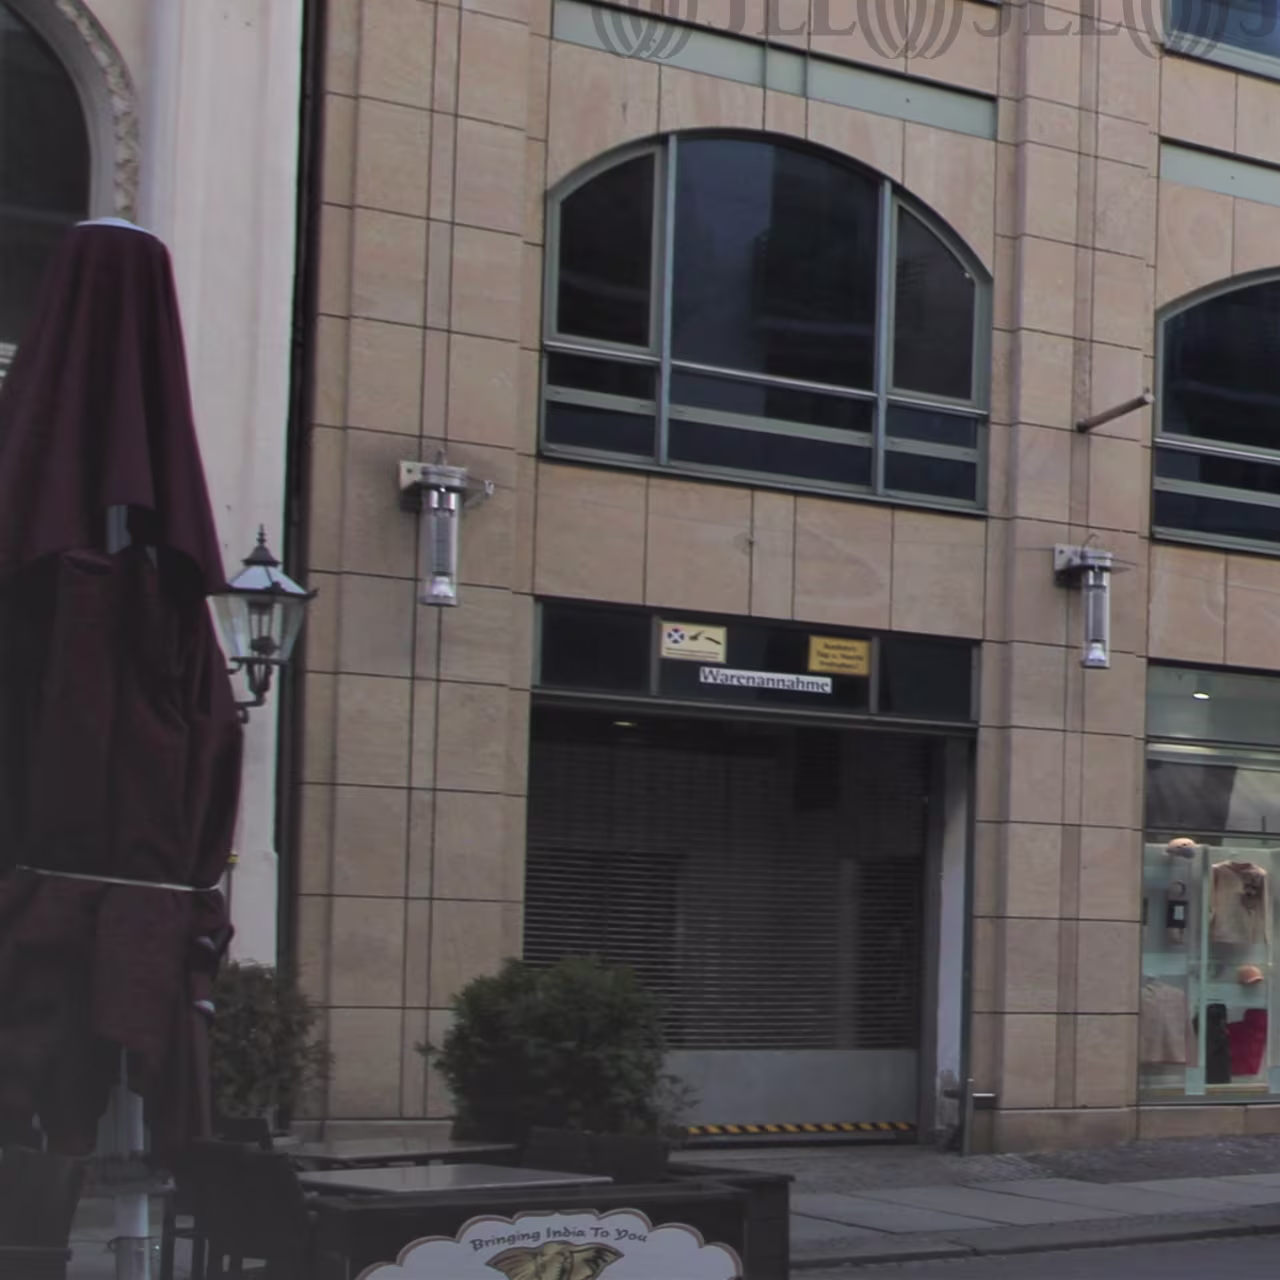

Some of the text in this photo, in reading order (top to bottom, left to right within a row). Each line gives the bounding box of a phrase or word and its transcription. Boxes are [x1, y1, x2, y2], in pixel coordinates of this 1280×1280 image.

[702, 669, 829, 692] Warenannahme
[470, 1227, 648, 1251] Bringing India To You
